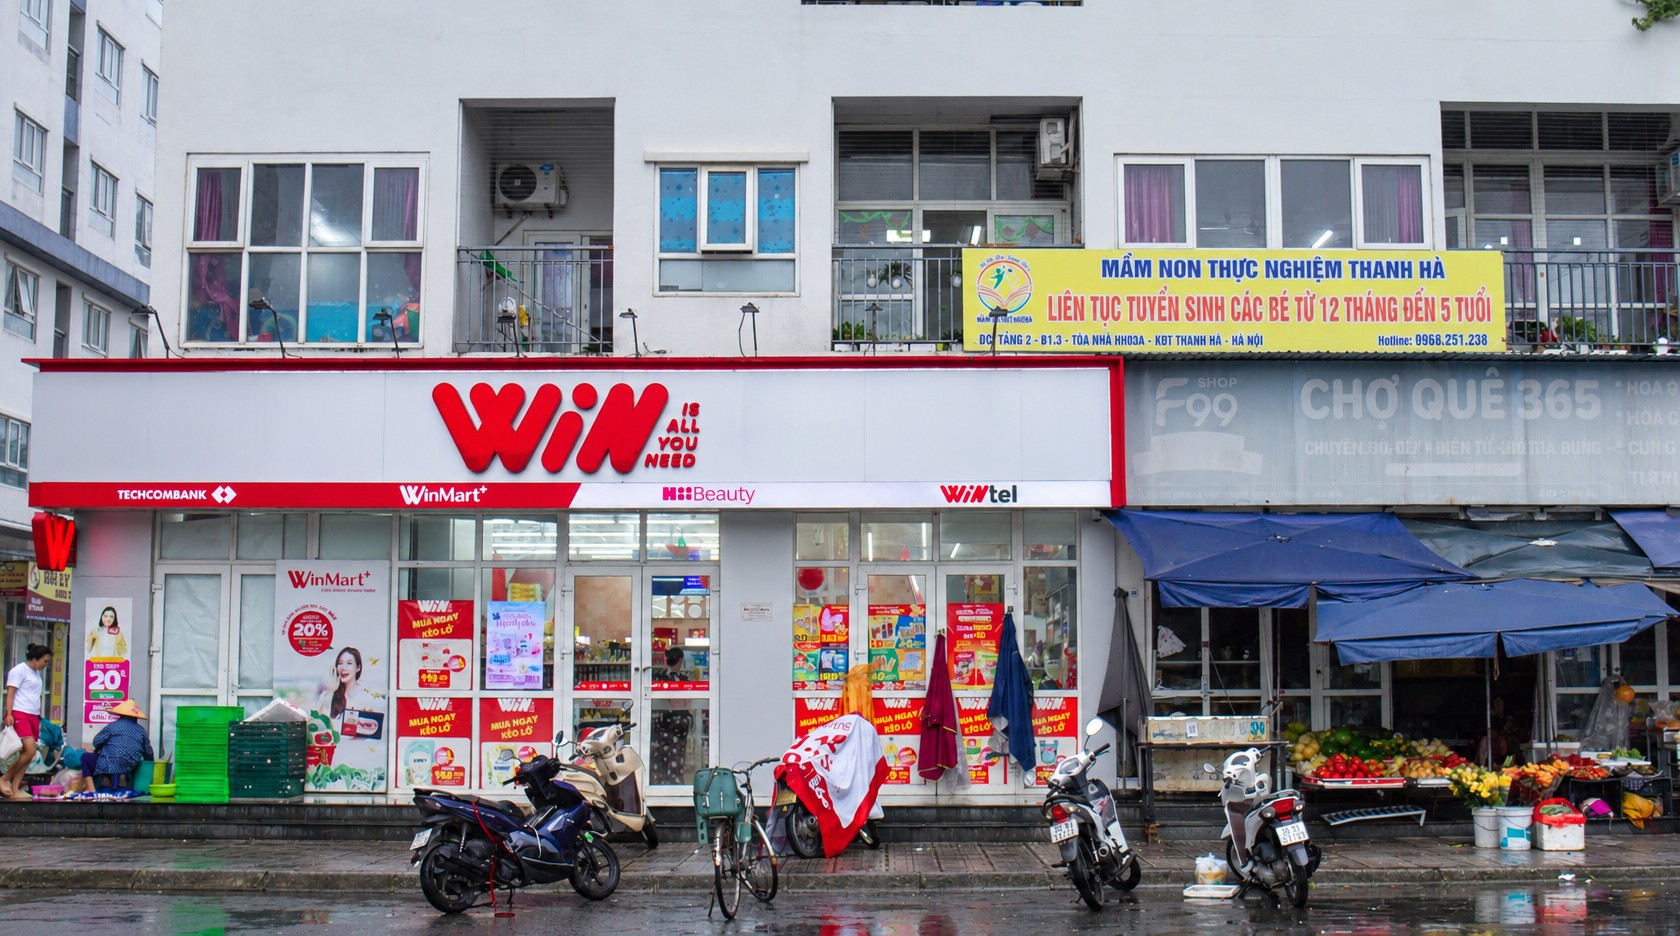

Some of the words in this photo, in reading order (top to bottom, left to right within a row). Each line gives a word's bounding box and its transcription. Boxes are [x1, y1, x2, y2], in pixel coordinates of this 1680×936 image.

[1102, 253, 1152, 278] MẦM
[1159, 259, 1201, 278] NON
[1208, 259, 1258, 282] THỰC
[1265, 256, 1342, 283] NGHIỆM
[1348, 259, 1413, 279] THANH
[1419, 256, 1445, 278] HÀ
[1048, 290, 1085, 321] LIÊN
[1090, 296, 1121, 327] TỤC
[1126, 286, 1179, 321] TUYỂN
[1185, 295, 1225, 322] SINH
[1231, 290, 1263, 322] CÁC
[1269, 290, 1290, 322] BÉ
[1295, 290, 1316, 322] TỪ
[1320, 296, 1340, 322] 12
[1344, 291, 1398, 322] THÁNG
[1403, 287, 1437, 322] ĐẾN
[1441, 297, 1451, 322] 5
[1455, 286, 1491, 322] TUỔI
[1041, 334, 1062, 345] B1.3
[1176, 334, 1207, 346] THANH
[1378, 335, 1412, 346] Hotline:
[1415, 334, 1488, 346] 0968.251.238
[1197, 377, 1238, 388] SHOP
[1155, 378, 1238, 427] F99
[1301, 374, 1400, 430] CHỢ
[1411, 366, 1506, 421] QUÊ
[1516, 378, 1601, 420] 365
[682, 402, 700, 416] IS
[666, 418, 700, 433] ALL
[658, 436, 698, 450] YOU
[644, 453, 696, 468] NEED
[117, 489, 207, 501] TECHCOMBANK
[412, 616, 432, 629] MUA
[293, 623, 329, 637] 20%
[88, 669, 121, 691] 20
[409, 717, 429, 727] MUA
[491, 720, 511, 731] MUA
